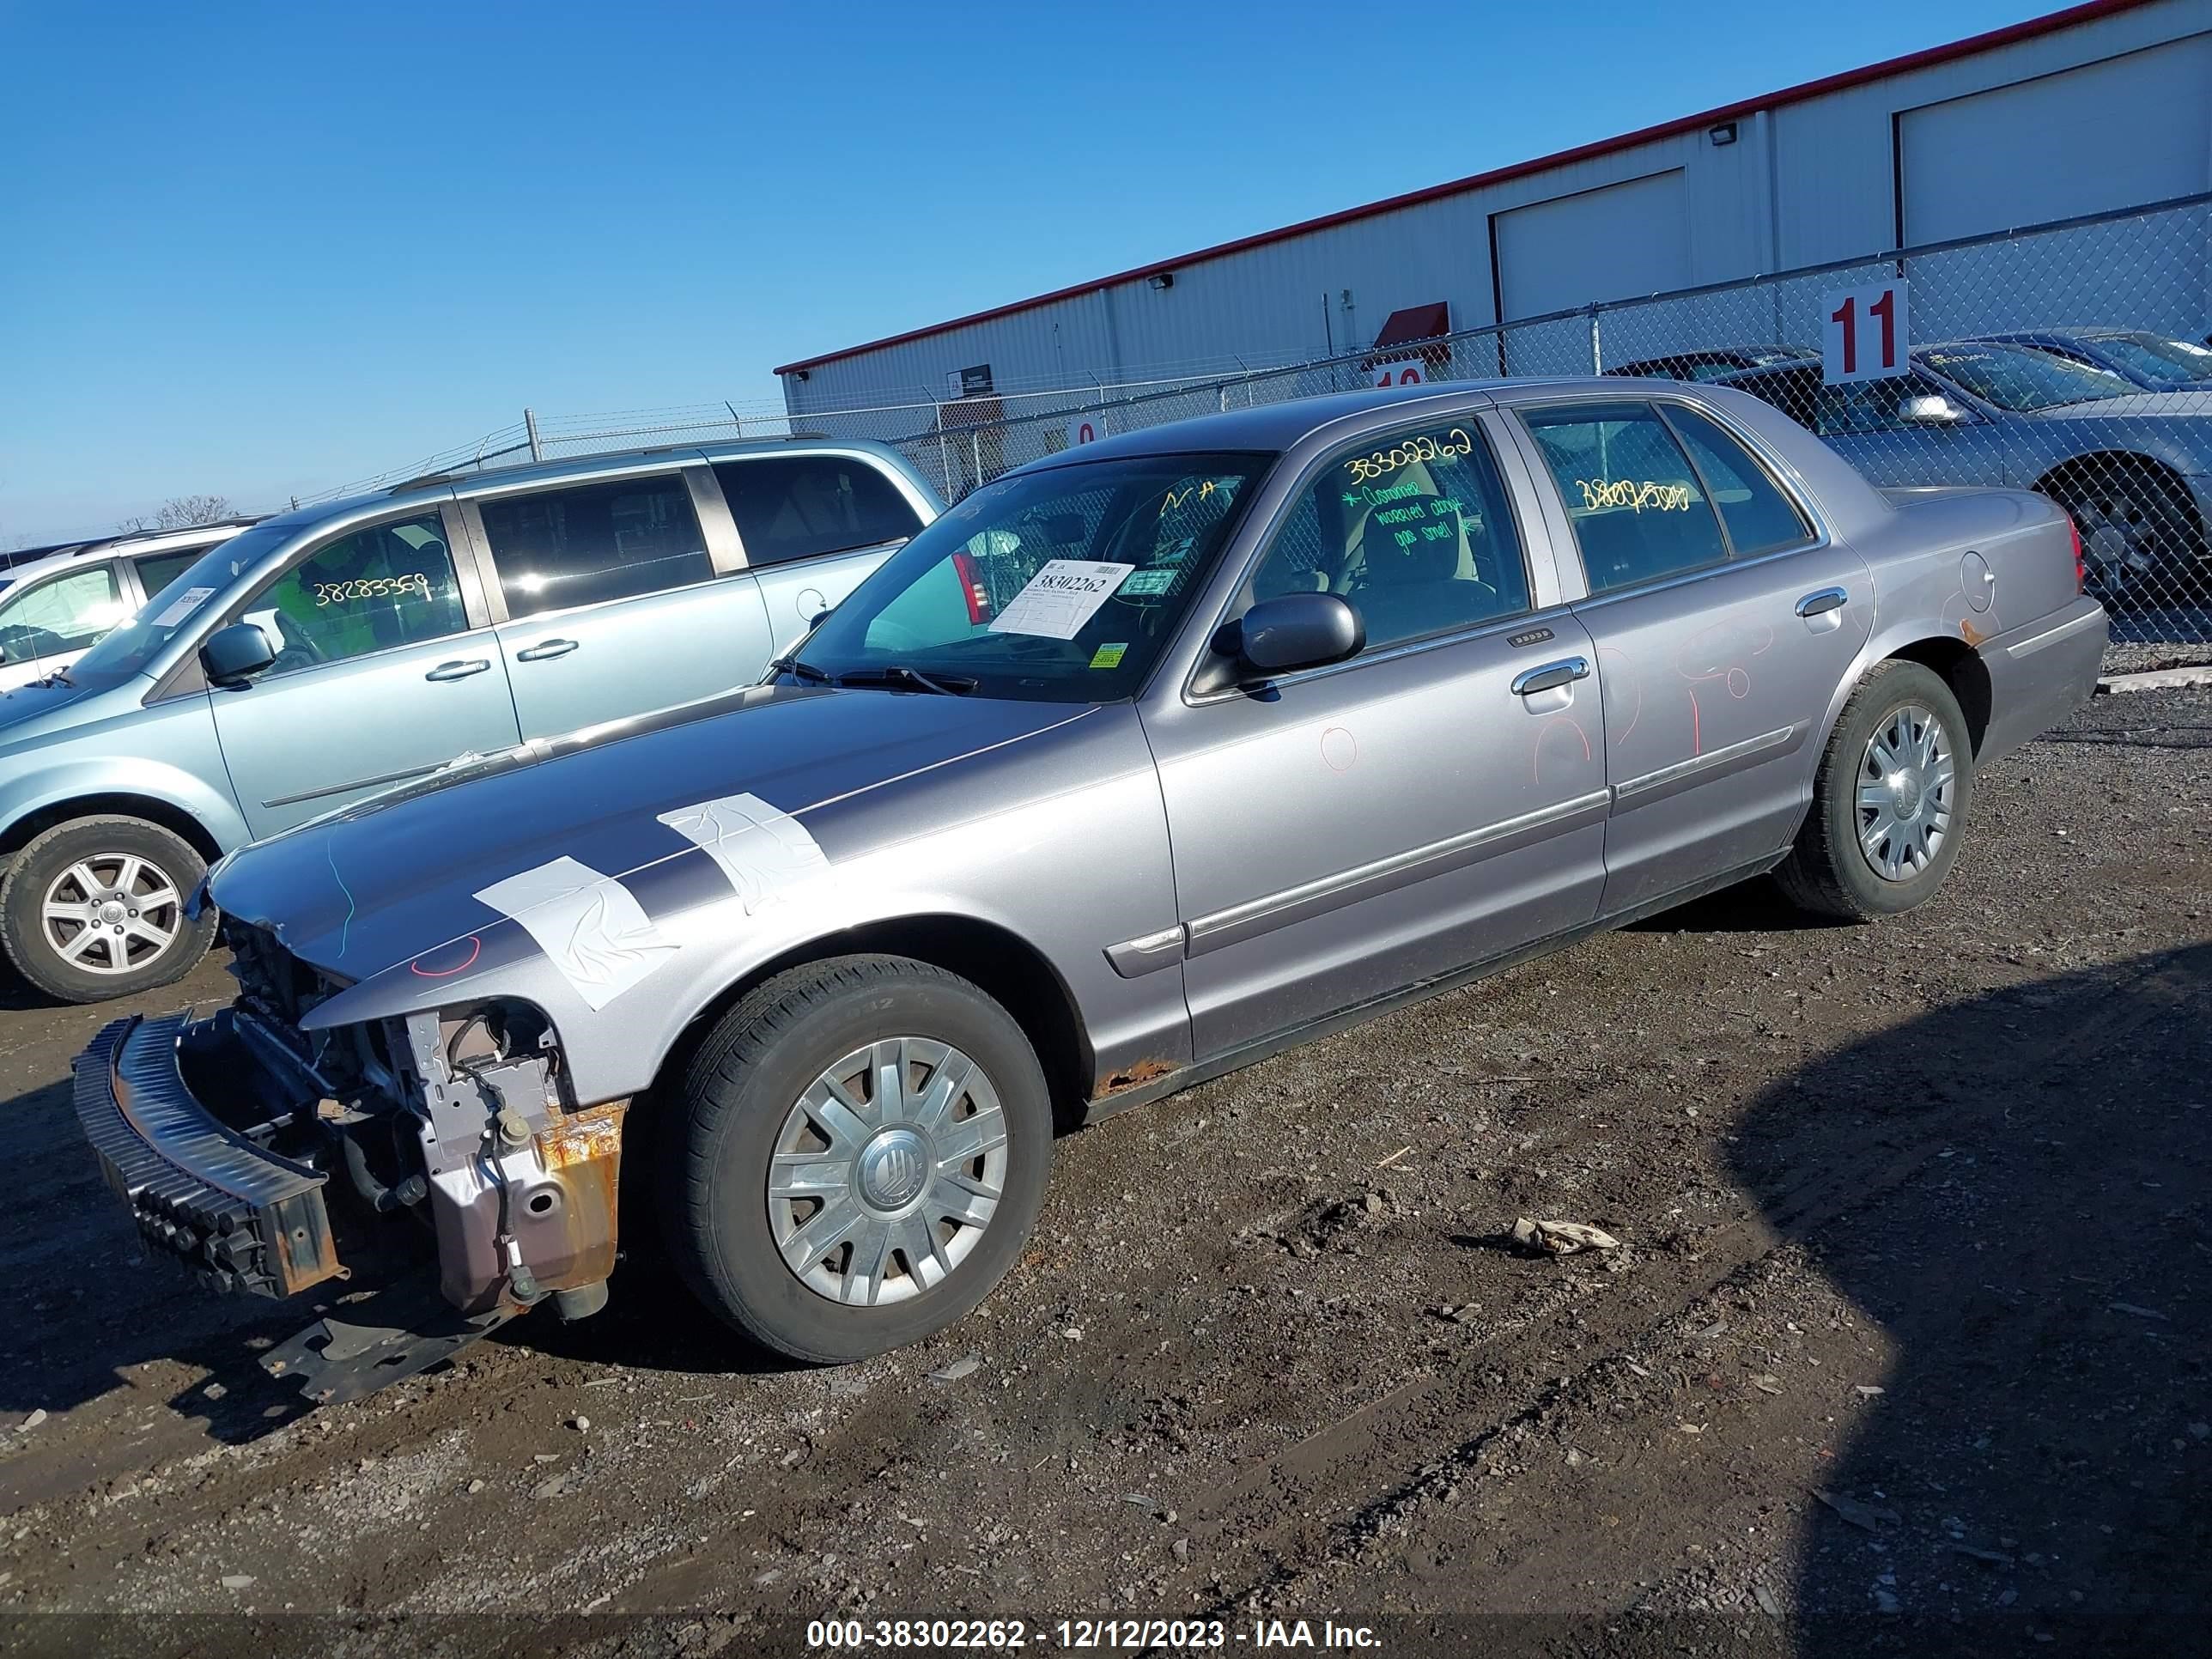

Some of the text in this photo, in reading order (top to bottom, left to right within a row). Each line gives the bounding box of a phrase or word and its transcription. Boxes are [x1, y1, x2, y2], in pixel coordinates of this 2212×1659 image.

[1832, 289, 1895, 374] 11
[1344, 428, 1474, 485] 38302262
[1395, 520, 1454, 556] gas smell
[313, 573, 432, 606] 38283369
[1035, 574, 1107, 593] 38302262
